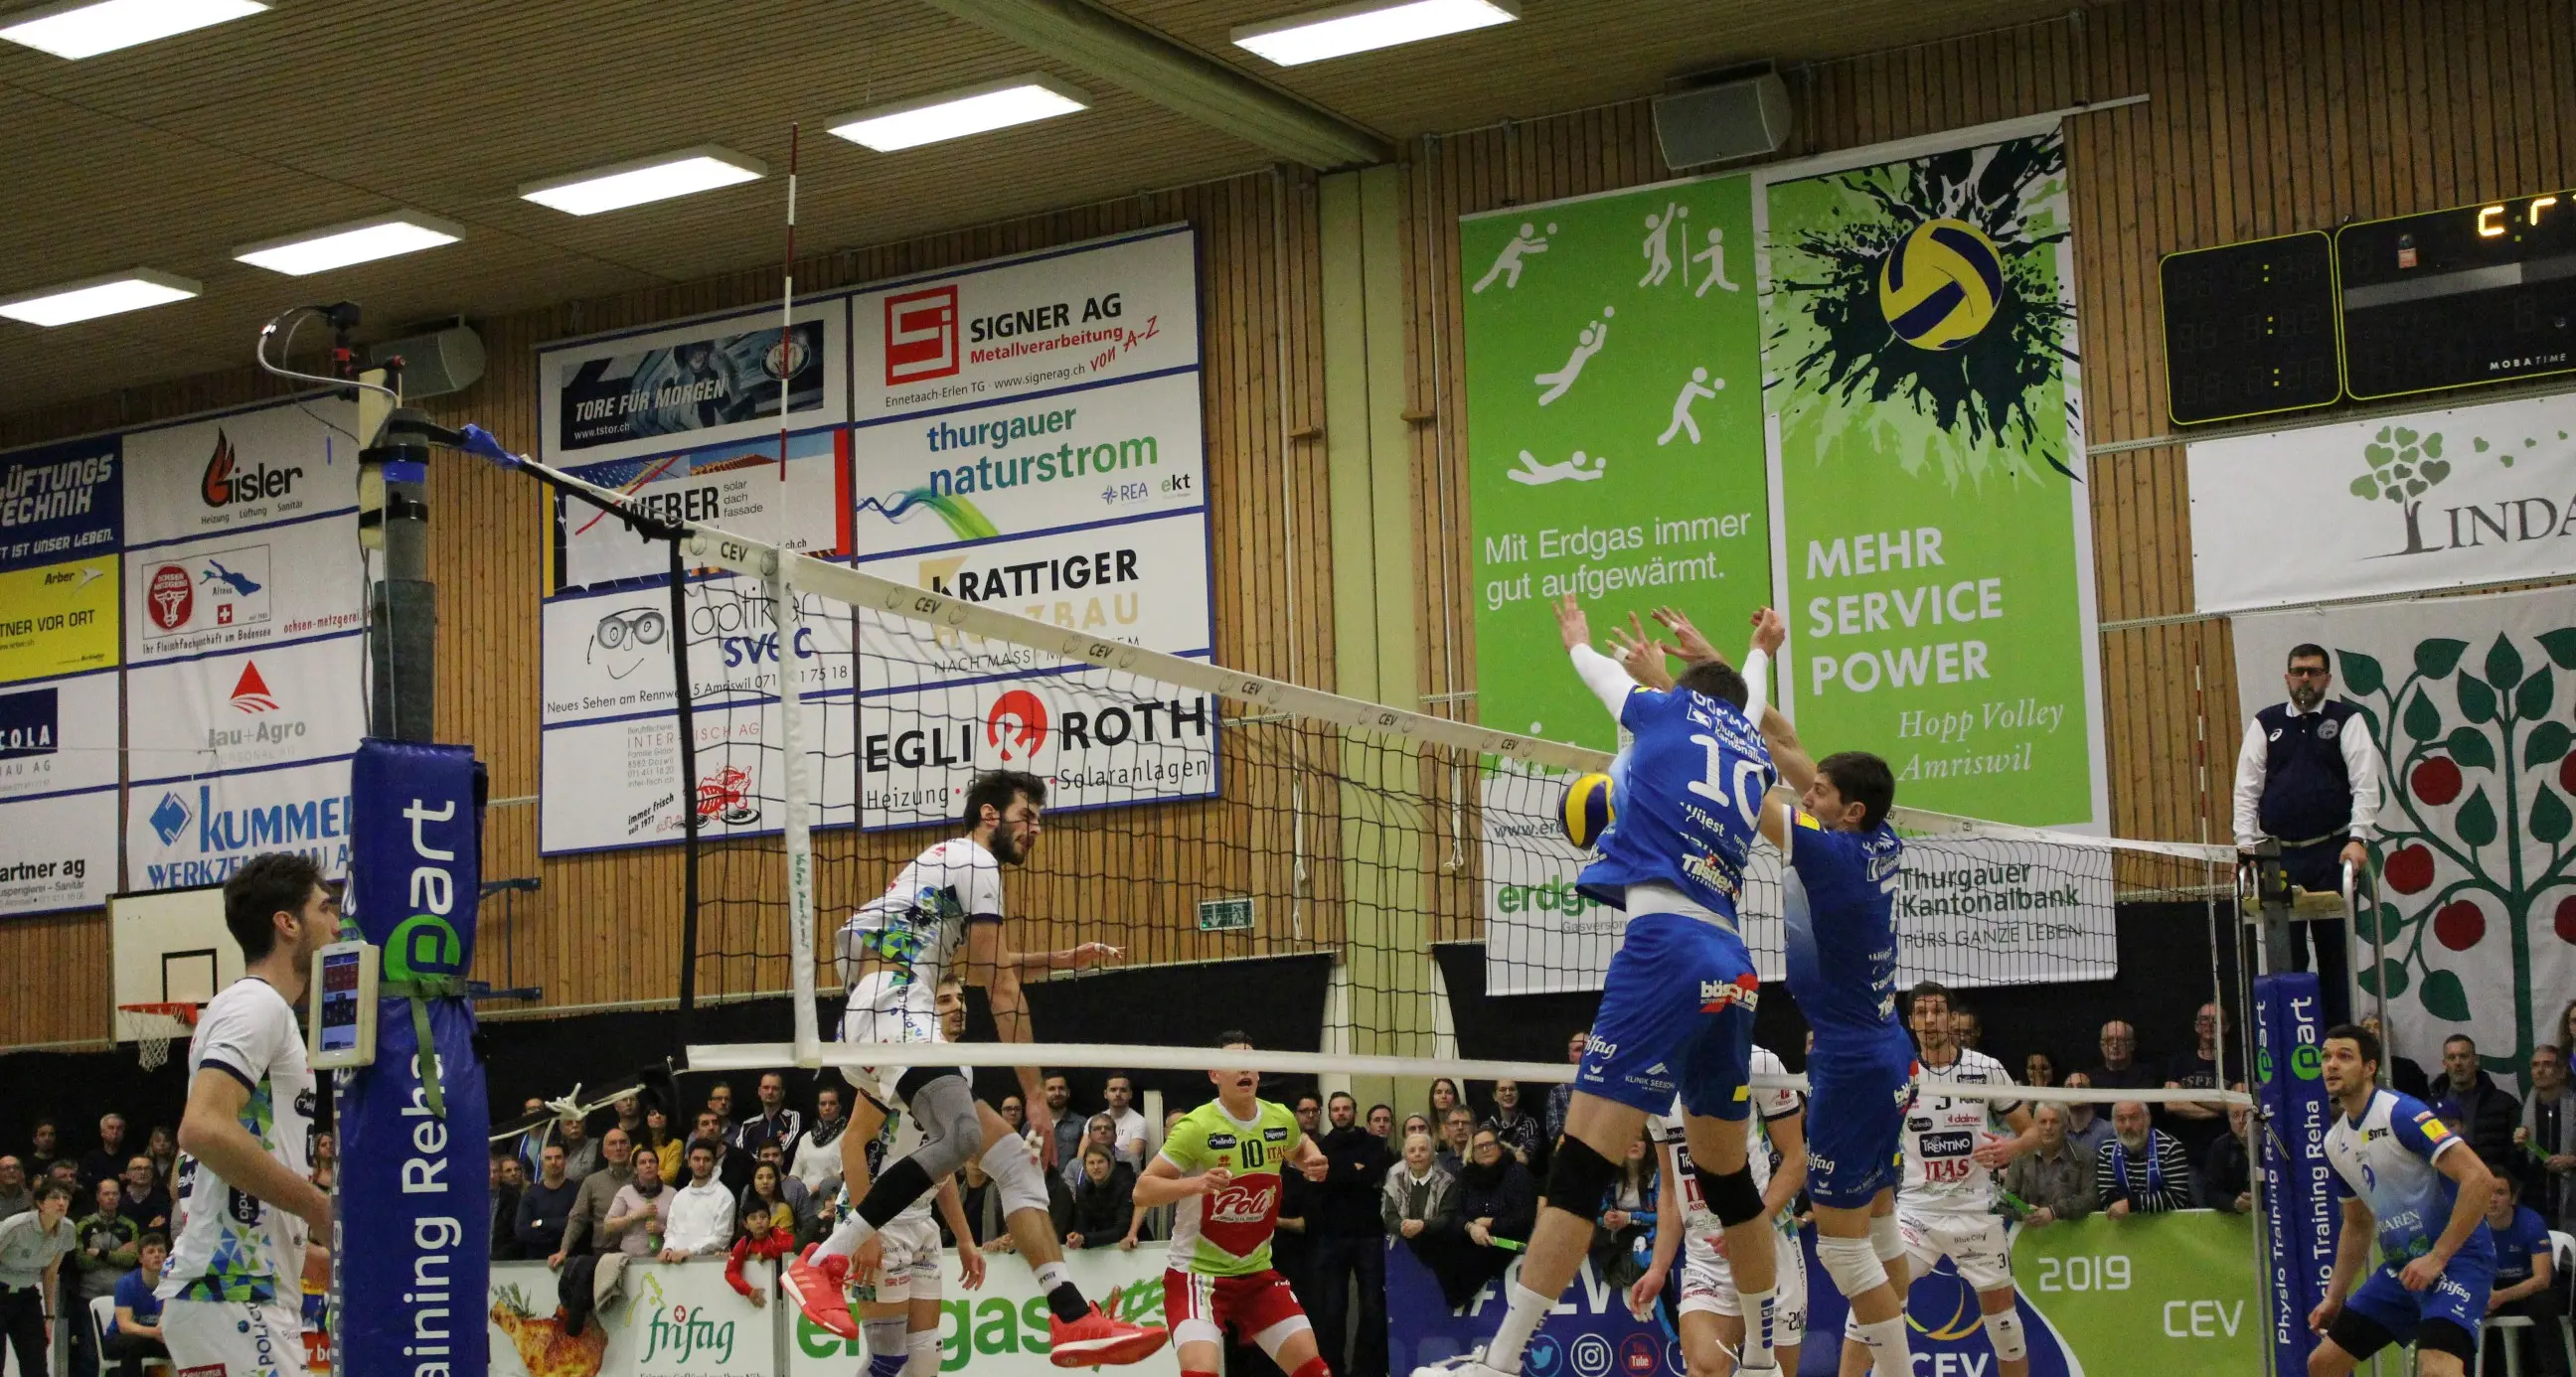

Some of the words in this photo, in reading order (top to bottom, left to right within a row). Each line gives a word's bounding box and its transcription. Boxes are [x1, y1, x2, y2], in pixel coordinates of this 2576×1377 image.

[970, 302, 1069, 343] SIGNER
[1081, 292, 1122, 323] AG
[970, 325, 1124, 364] Metallverarbeitung
[1090, 346, 1116, 373] von
[575, 396, 613, 422] TORE
[618, 388, 649, 414] FÜR
[655, 379, 724, 408] MORGEN
[886, 383, 968, 407] Ennetaach-Erlen
[970, 382, 986, 392] TG
[994, 364, 1085, 389] www.signerag.ch
[573, 420, 630, 441] www.tstor.ch
[926, 407, 1077, 452] thurgauer
[929, 435, 1159, 499] naturstrom
[724, 480, 747, 493] solar
[1120, 482, 1148, 502] REA
[1161, 474, 1192, 493] ekt
[201, 514, 230, 525] Heizung
[239, 507, 267, 520] Lüftung
[277, 501, 303, 513] Sanitär
[724, 493, 748, 505] dach
[724, 504, 763, 518] fassade
[12, 542, 30, 558] IST
[34, 536, 71, 554] UNSER
[721, 541, 748, 562] CEV
[1486, 534, 1529, 565] Mit
[1539, 526, 1644, 561] Erdgas
[1655, 513, 1751, 545] immer
[1807, 527, 1946, 580] MEHR
[45, 572, 75, 586] Arber
[932, 548, 1139, 603] KRATTIGER
[1486, 573, 1532, 611] gut
[1541, 551, 1726, 600] aufgewärmt.
[38, 614, 65, 633] VOR
[70, 609, 95, 628] ORT
[284, 605, 371, 634] ochsen-metzgerei.h
[914, 597, 942, 615] CEV
[1809, 577, 2004, 638] SERVICE
[143, 644, 153, 655] Ihr
[225, 632, 235, 642] am
[238, 627, 271, 641] Bodensee
[1089, 643, 1115, 659] CEV
[988, 650, 1032, 667] MASS
[1812, 640, 1991, 696] POWER
[547, 699, 578, 714] Neues
[582, 695, 616, 710] Sehen
[620, 695, 636, 706] am
[704, 678, 752, 694] Amriswil
[754, 674, 778, 688] 071
[811, 668, 827, 682] 75
[832, 667, 848, 680] 18
[1241, 681, 1263, 694] CEV
[738, 722, 760, 737] AG
[866, 724, 972, 773] EGLI
[1061, 696, 1207, 751] ROTH
[1377, 713, 1397, 726] CEV
[1897, 709, 1974, 743] Hopp
[1983, 698, 2064, 733] Volley
[1501, 738, 1520, 751] CEV
[1897, 743, 2032, 782] Amriswil
[868, 786, 949, 810] Heizung
[1059, 759, 1208, 791] Solaranlagen
[1688, 734, 1766, 832] 10
[628, 806, 651, 826] immer
[653, 792, 674, 812] frisch
[63, 858, 85, 878] ag
[1899, 862, 2030, 892] Thurgauer
[1901, 884, 2081, 918] Kantonalbank
[1904, 930, 1947, 950] FÜRS
[1955, 922, 2019, 945] GANZE
[2026, 923, 2083, 942] LEBEN
[402, 1053, 448, 1194] Reha
[2306, 1100, 2327, 1158] Reha
[1240, 1139, 1265, 1169] 10
[1921, 1137, 1971, 1153] TRENTINO
[1924, 1159, 1970, 1182] ITAS
[2361, 1163, 2376, 1193] 9
[2267, 1168, 2285, 1262] Training
[2313, 1166, 2332, 1262] Training
[1998, 1252, 2007, 1270] 3
[2038, 1255, 2131, 1292] 2019
[2164, 1300, 2244, 1337] CEV
[2269, 1267, 2293, 1345] Physio
[641, 1306, 735, 1365] frifag
[1631, 1355, 1651, 1367] Tube
